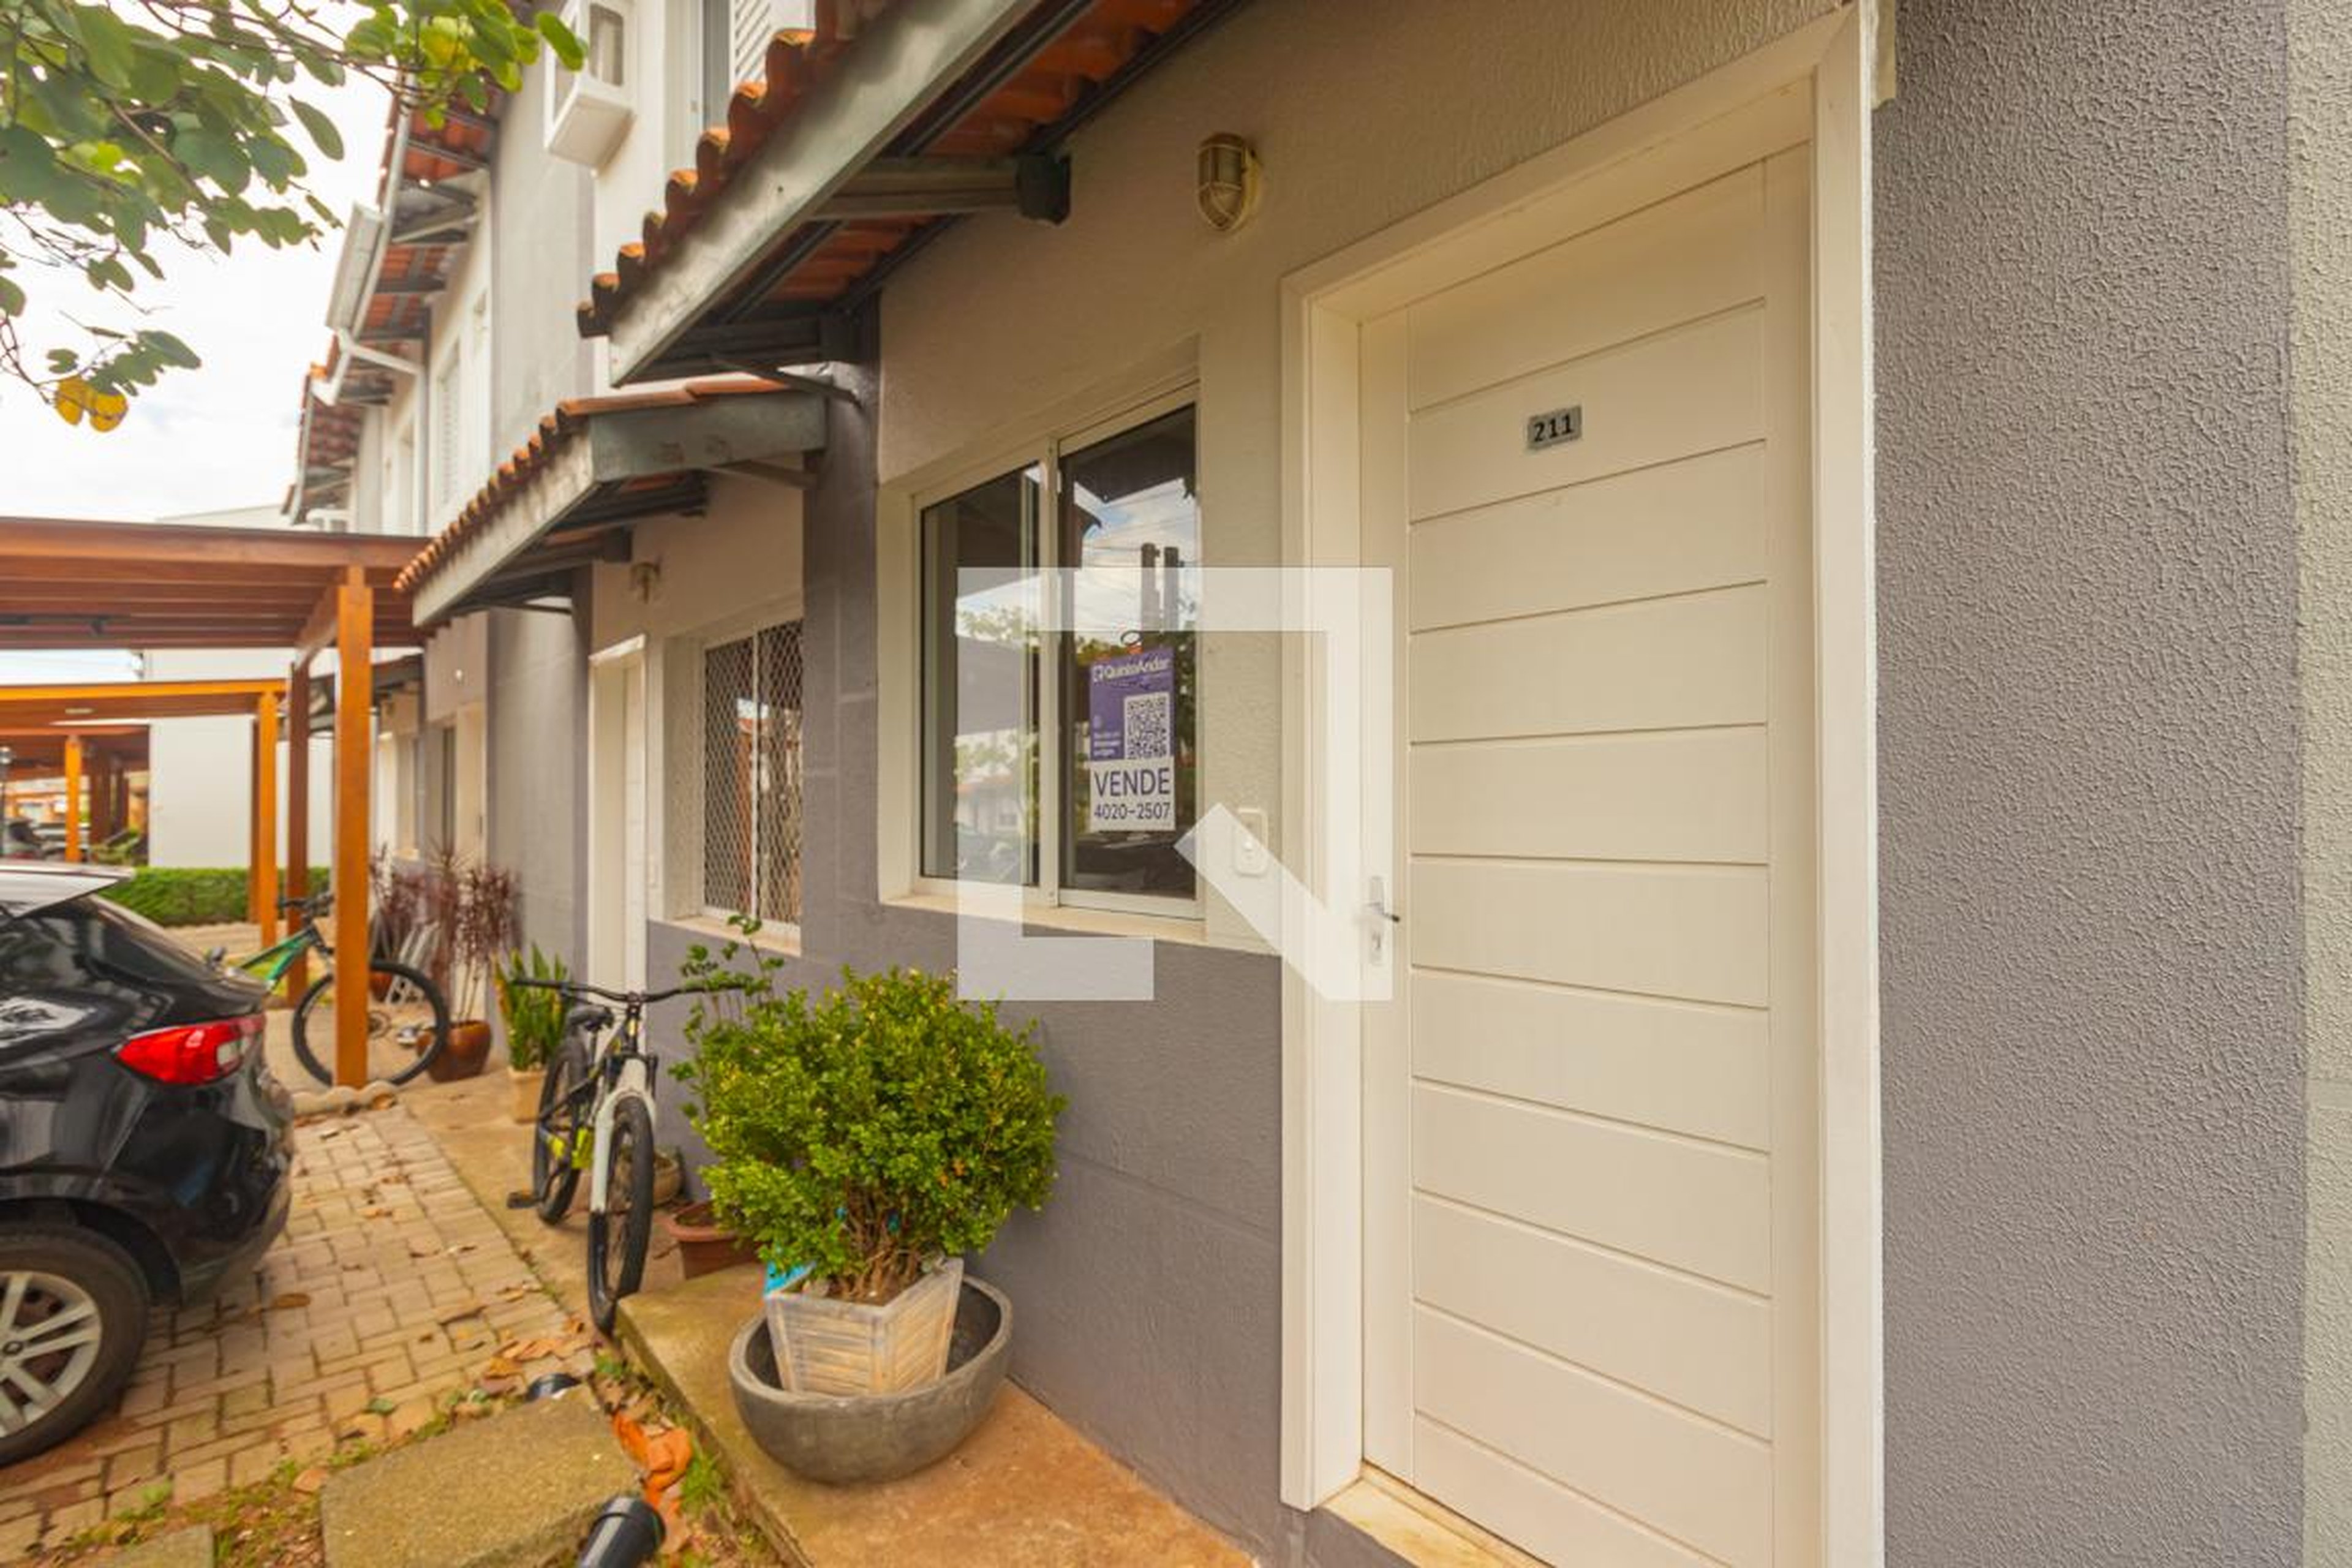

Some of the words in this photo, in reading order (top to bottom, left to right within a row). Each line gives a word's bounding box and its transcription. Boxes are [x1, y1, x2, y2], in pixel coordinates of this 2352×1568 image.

[1533, 413, 1573, 442] 211
[1094, 767, 1170, 797] VENDE
[1094, 802, 1170, 820] 4020-2507
